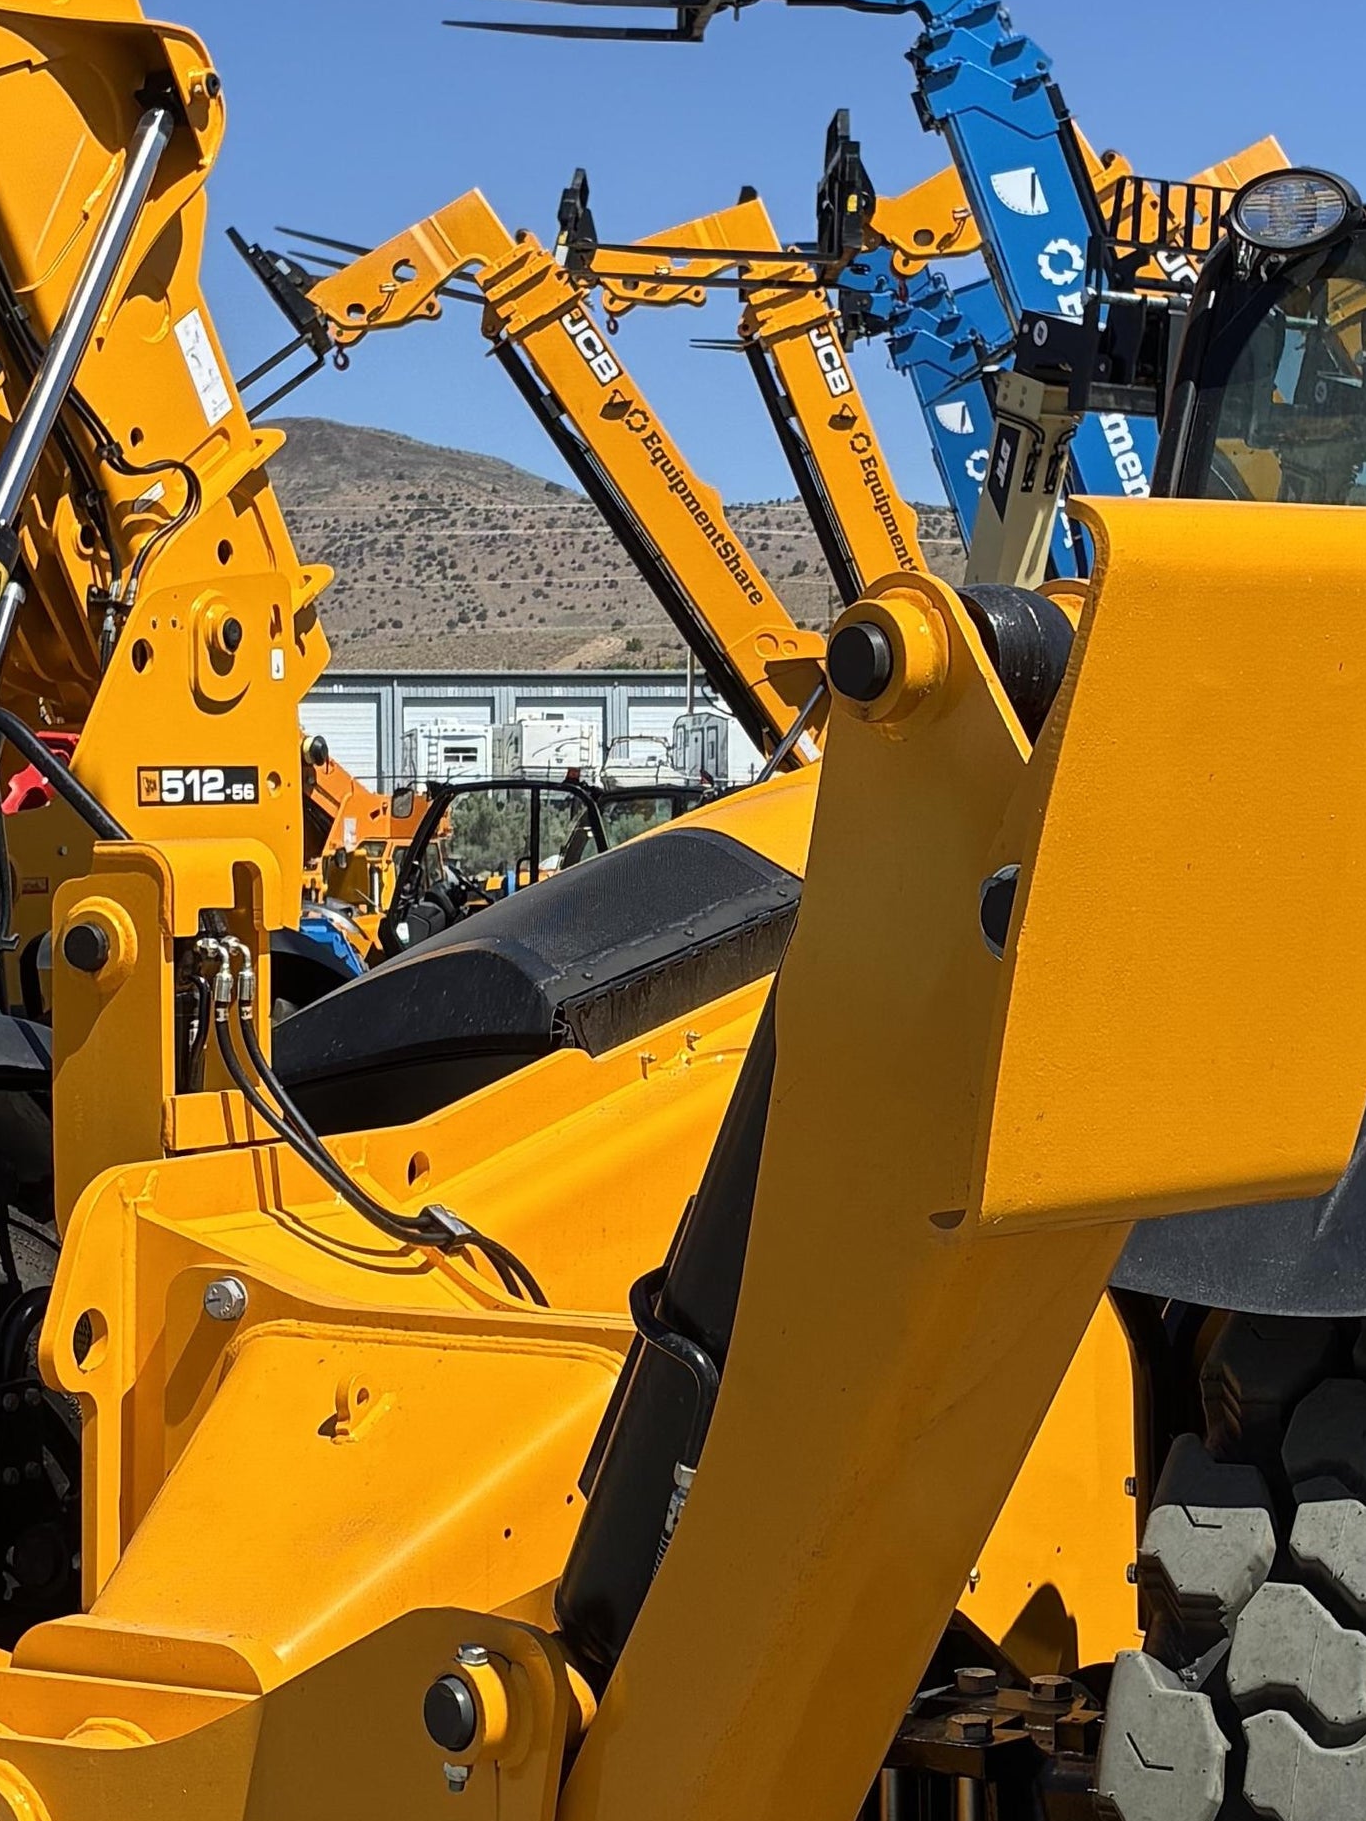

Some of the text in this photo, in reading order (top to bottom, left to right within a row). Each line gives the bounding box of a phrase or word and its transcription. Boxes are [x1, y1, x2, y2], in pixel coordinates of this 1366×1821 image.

[561, 311, 620, 384] JCB
[809, 329, 851, 395] JCB
[995, 438, 1012, 489] JLG
[641, 430, 764, 607] EquipmentShare
